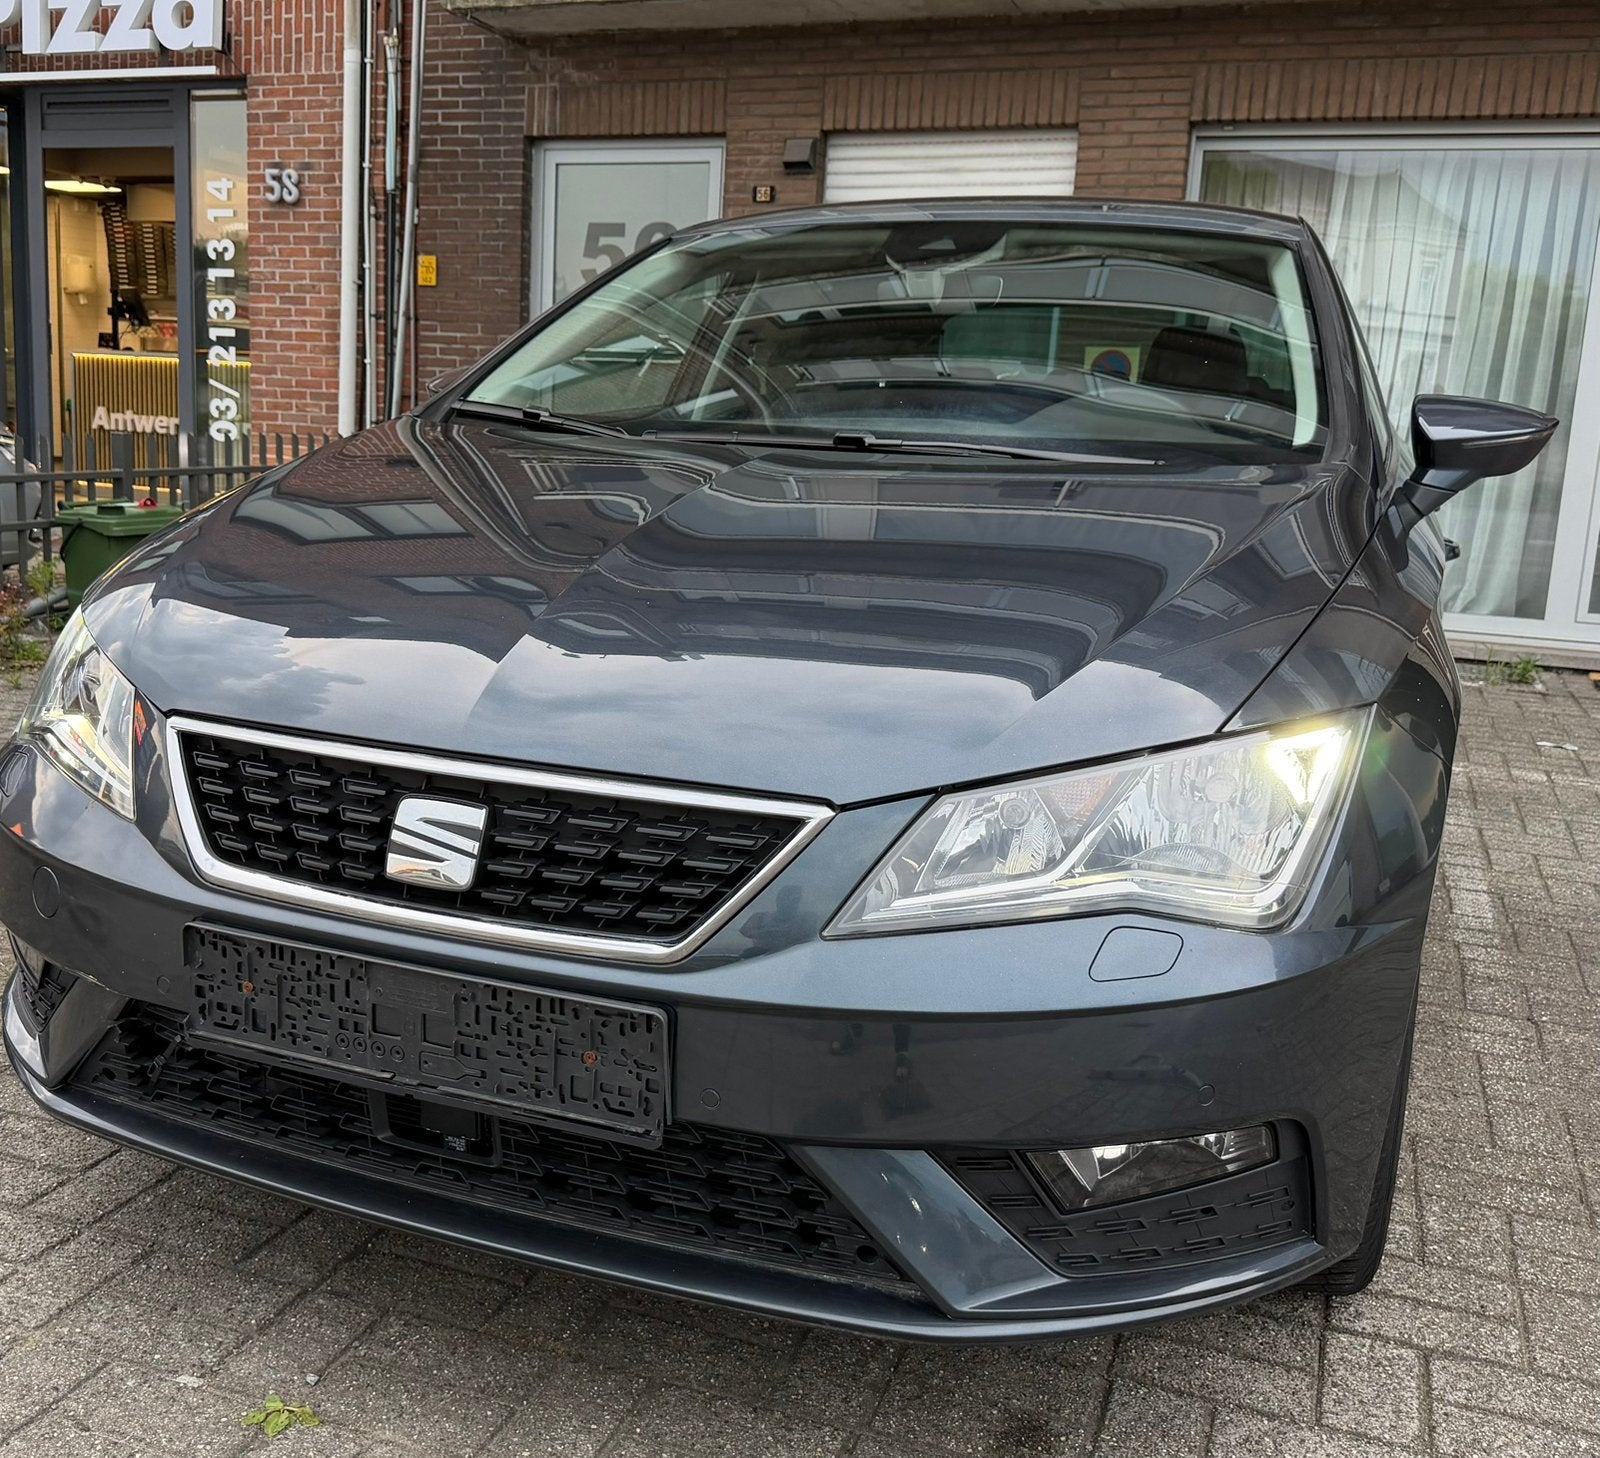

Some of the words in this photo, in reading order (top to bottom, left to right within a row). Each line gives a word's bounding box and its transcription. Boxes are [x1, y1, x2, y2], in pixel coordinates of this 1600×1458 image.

[0, 0, 222, 54] izza
[206, 178, 235, 223] 14
[265, 168, 300, 203] 58
[757, 188, 770, 201] 56
[206, 238, 236, 282] 13
[207, 298, 237, 368] 213
[208, 378, 240, 442] 03/
